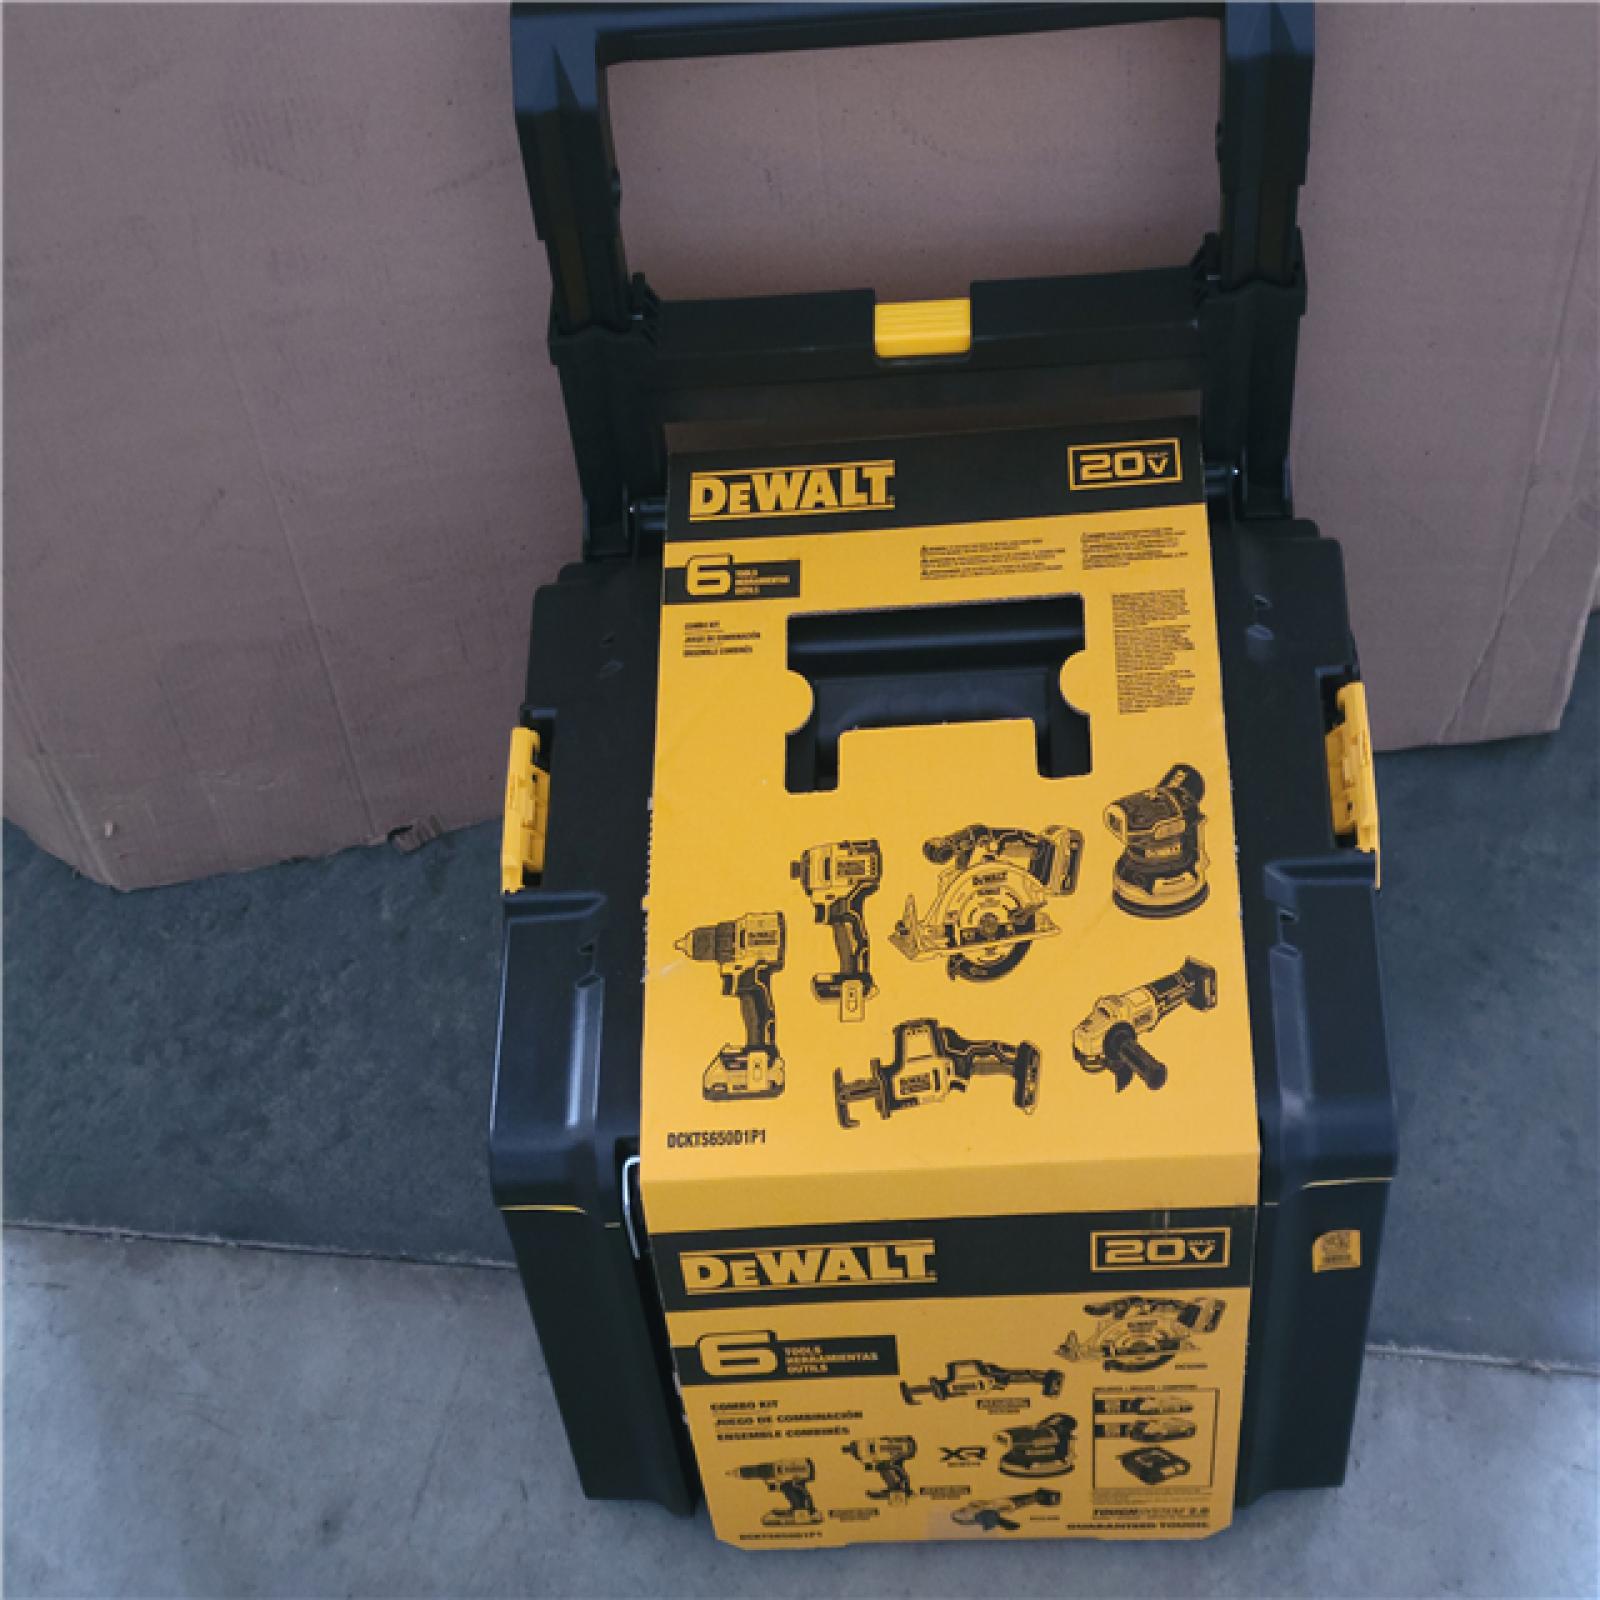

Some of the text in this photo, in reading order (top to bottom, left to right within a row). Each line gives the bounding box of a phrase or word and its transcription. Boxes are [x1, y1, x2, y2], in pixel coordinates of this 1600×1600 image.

[686, 553, 732, 596] 6
[1104, 1239, 1215, 1263] 20V
[698, 1331, 778, 1376] 6
